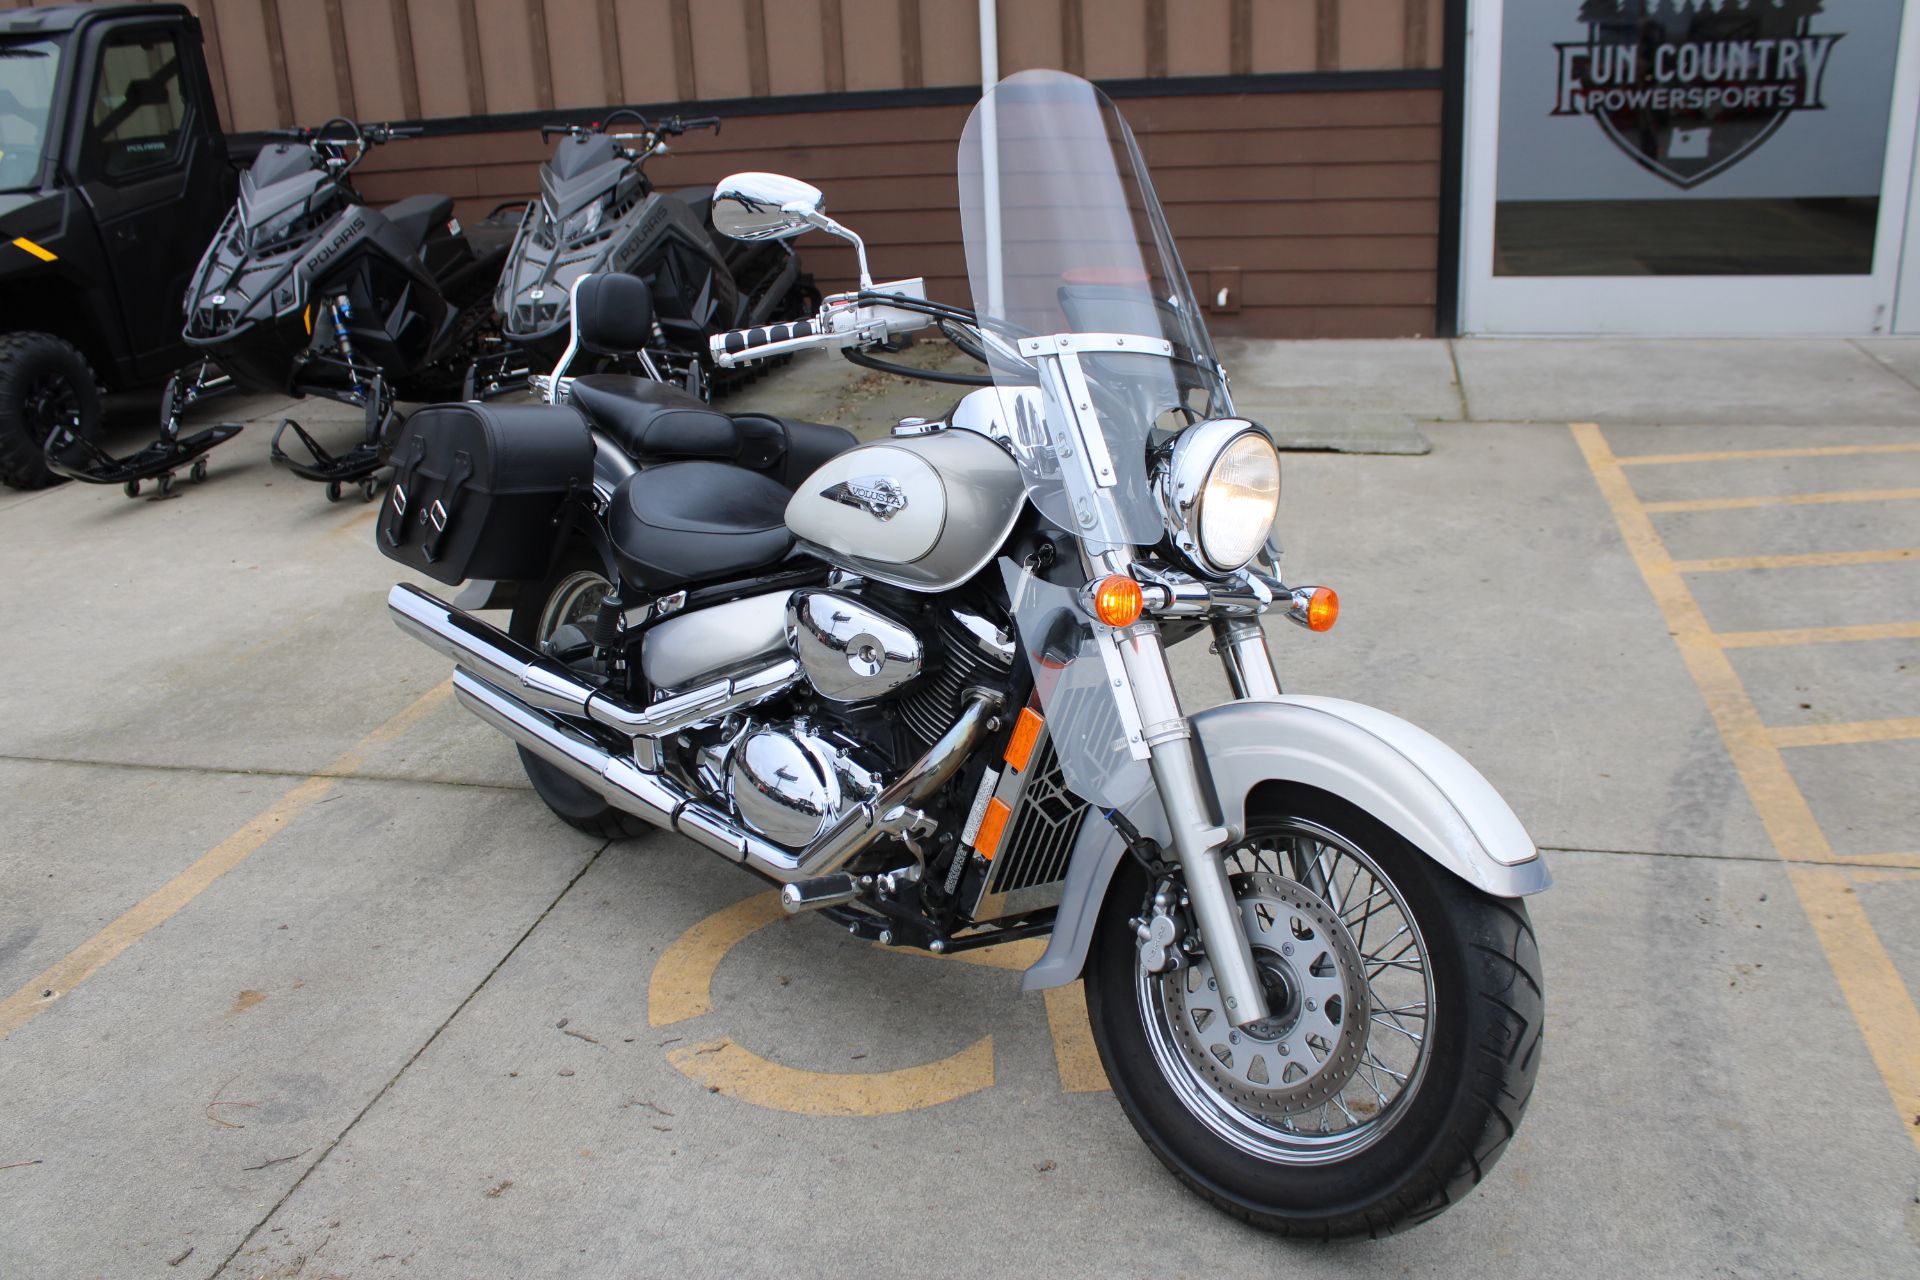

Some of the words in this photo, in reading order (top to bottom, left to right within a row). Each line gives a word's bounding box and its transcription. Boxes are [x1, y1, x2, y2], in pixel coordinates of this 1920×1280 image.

[1553, 44, 1637, 114] FUN
[1654, 35, 1838, 109] COUNTRY
[1588, 85, 1797, 112] POWERSPORTS
[306, 217, 366, 272] POLARIS
[620, 205, 668, 262] POLARIS
[851, 486, 901, 507] VOLUSIA
